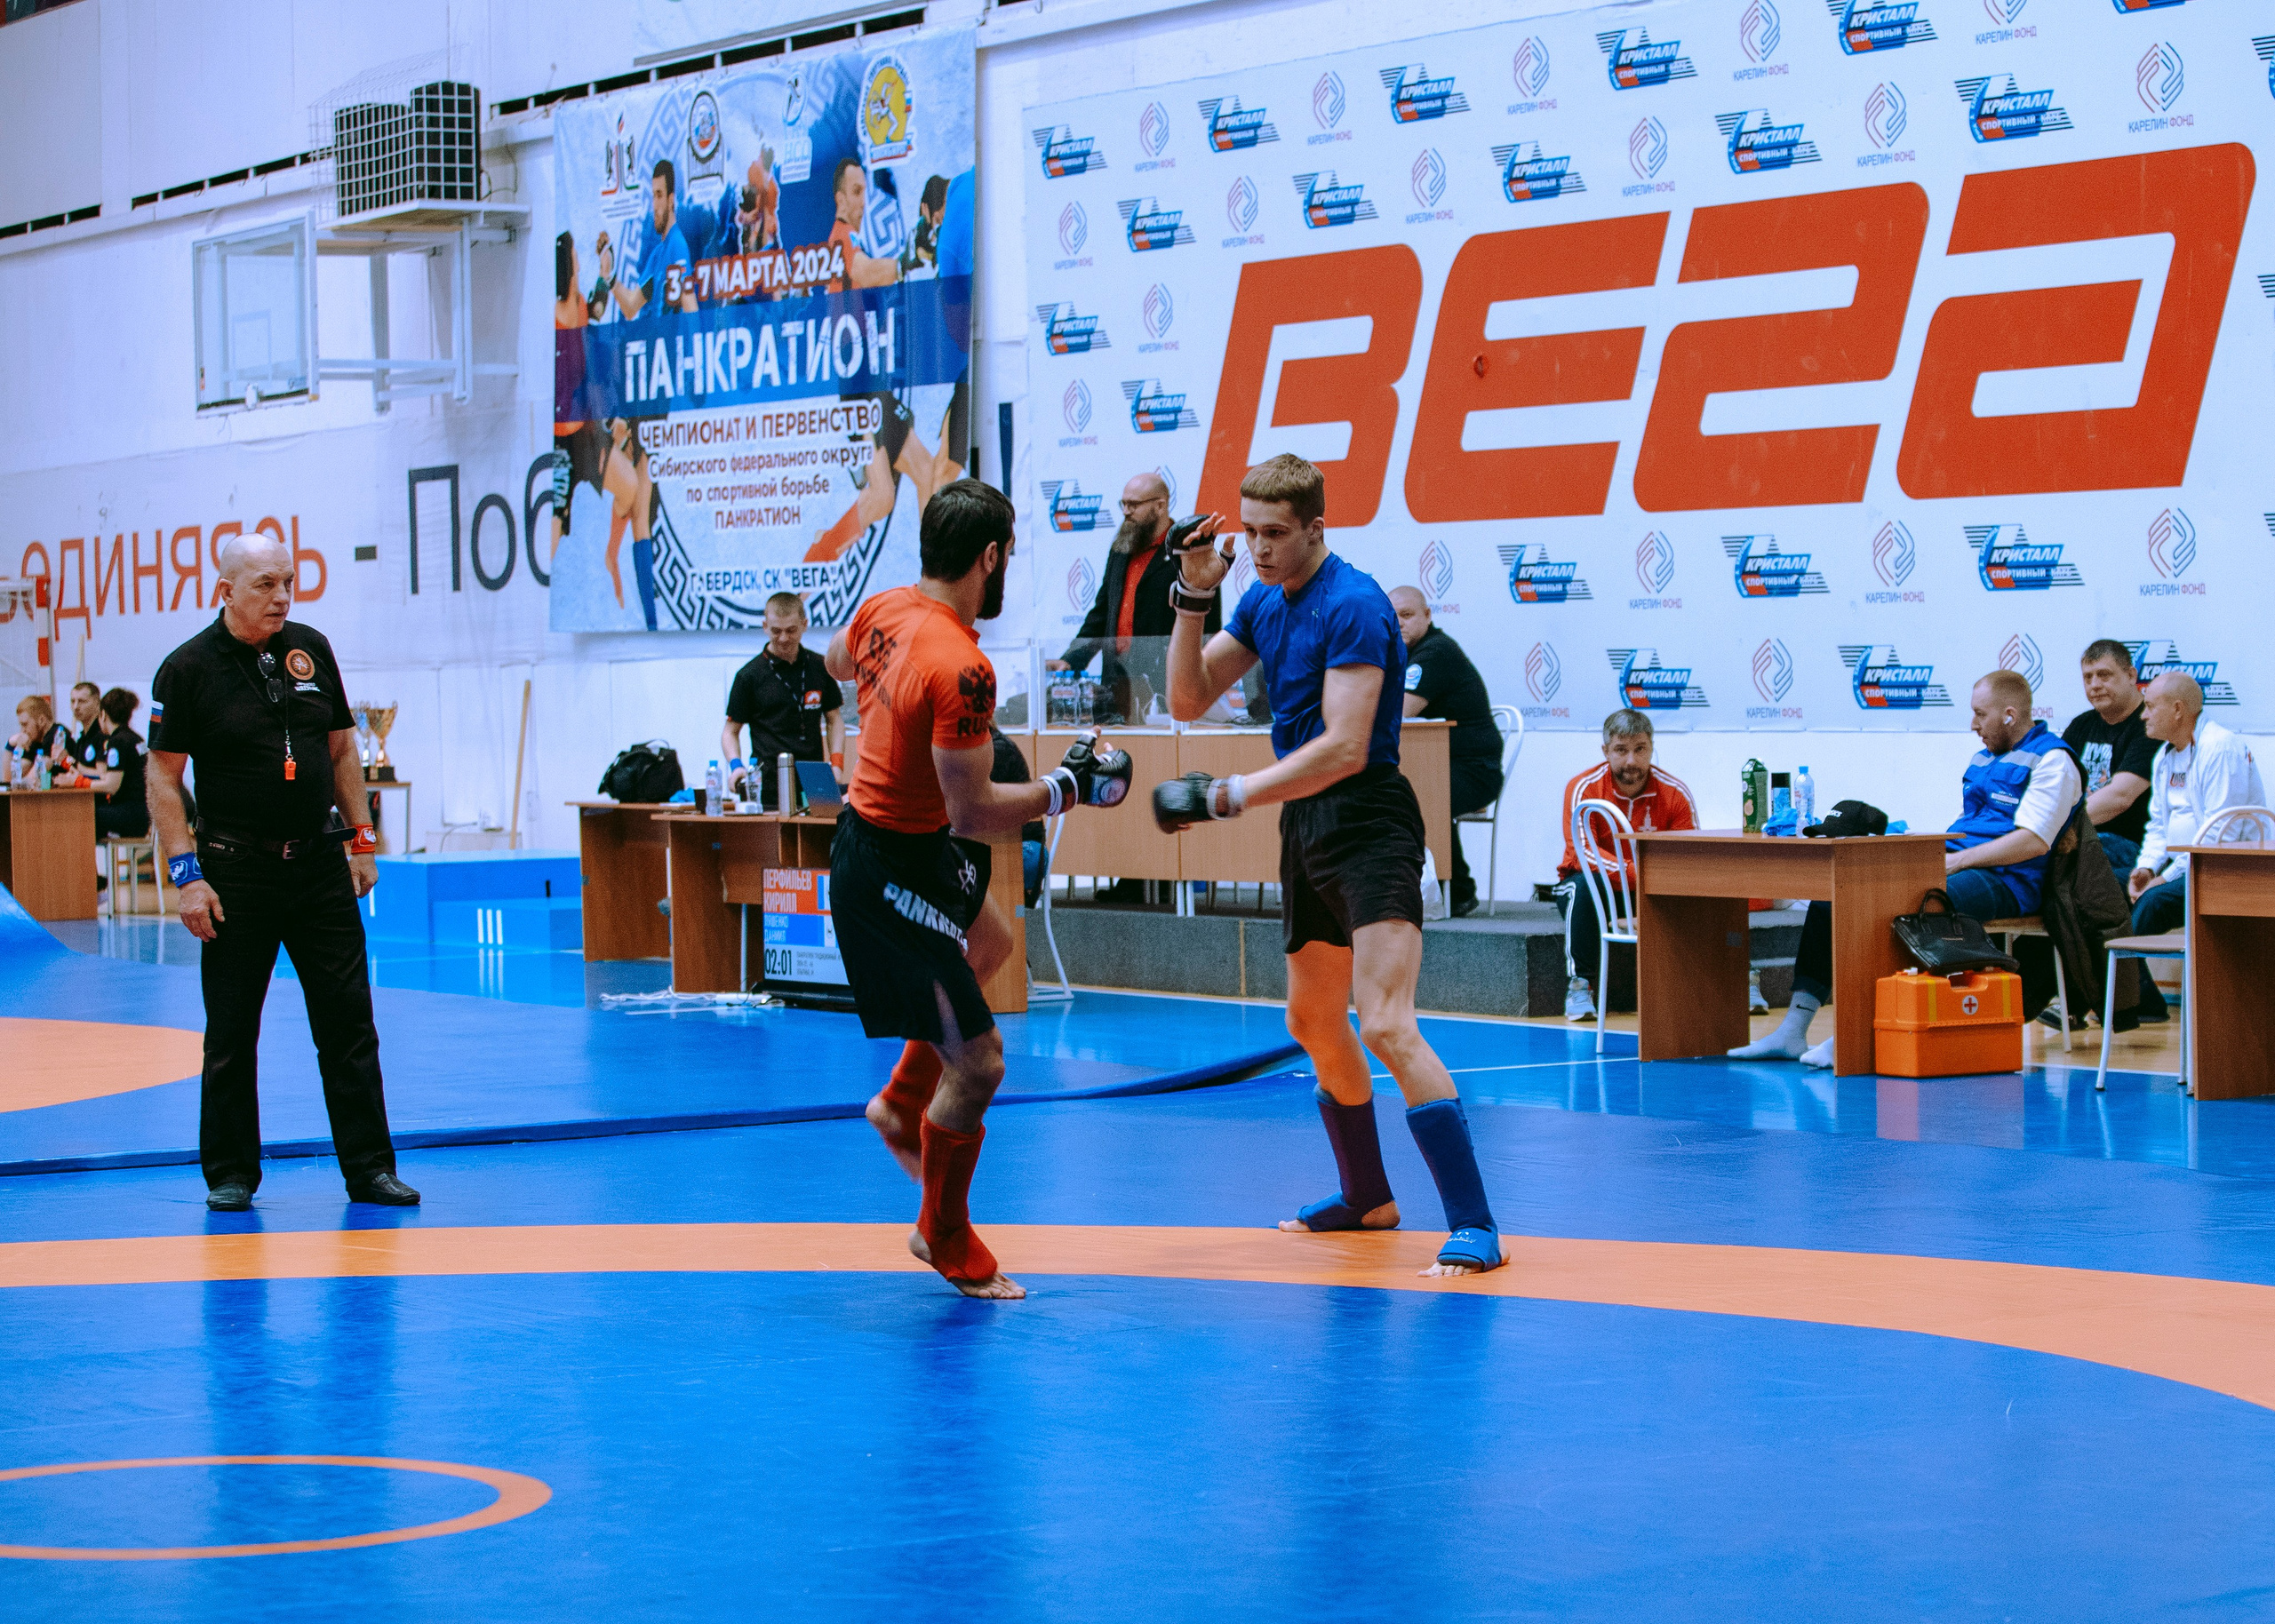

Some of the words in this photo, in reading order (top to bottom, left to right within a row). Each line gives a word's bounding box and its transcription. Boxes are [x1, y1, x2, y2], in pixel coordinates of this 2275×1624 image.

[1850, 5, 1914, 28] КРИСТАЛЛ
[1976, 28, 2013, 44] КАРЕЛИН
[2014, 26, 2037, 39] ФОНД
[1619, 44, 1678, 64] КРИСТАЛЛ
[1733, 68, 1767, 81] КАРЕЛИН
[1768, 64, 1789, 76] ФОНД
[1401, 79, 1453, 100] КРИСТАЛЛ
[1981, 92, 2050, 115] КРИСТАЛЛ
[1982, 115, 2036, 131] СПОРТИВНЫЙ
[2128, 117, 2168, 133] КАРЕЛИН
[2170, 114, 2194, 126] ФОНД
[1739, 127, 1800, 147] КРИСТАЛЛ
[1857, 152, 1892, 167] КАРЕЛИН
[1894, 150, 1915, 162] ФОНД
[1513, 158, 1569, 179] КРИСТАЛЛ
[1623, 186, 1655, 197] КАРЕЛИН
[1656, 181, 1675, 193] ФОНД
[667, 268, 682, 301] 3
[697, 266, 710, 297] 7
[713, 254, 789, 295] МАРТА
[793, 245, 844, 284] 2024
[625, 307, 895, 402] ПАНКРАТИОН
[641, 418, 740, 448] ЧЕМПИОНАТ
[746, 415, 756, 439] И
[762, 404, 881, 438] ПЕРВЕНСТВО
[650, 456, 726, 479] Сибирского
[730, 449, 818, 475] федерального
[822, 444, 873, 466] округа
[687, 487, 702, 504] по
[707, 477, 777, 504] спортивной
[782, 474, 830, 499] борьбе
[715, 505, 801, 529] ПАНКРАТИОН
[1991, 547, 2060, 563] КРИСТАЛЛ
[1520, 564, 1574, 579] КРИСТАЛЛ
[1744, 557, 1808, 572] КРИСТАЛЛ
[1991, 568, 2046, 579] СПОРТИВНЫЙ
[763, 568, 781, 589] СК
[1866, 593, 1902, 604] КАРЕЛИН
[1903, 591, 1925, 603] ФОНД
[2140, 584, 2180, 596] КАРЕЛИН
[2181, 583, 2206, 595] ФОНД
[1630, 599, 1661, 609] КАРЕЛИН
[1662, 598, 1682, 609] ФОНД
[1629, 671, 1688, 684] КРИСТАЛЛ
[1865, 668, 1930, 682] КРИСТАЛЛ
[1865, 689, 1917, 697] СПОРТИВНЫЙ
[1551, 707, 1569, 719] ФОНД
[1747, 707, 1780, 719] КАРЕЛИН
[1782, 707, 1802, 719] ФОНД
[763, 869, 812, 891] ПЕРФИЛЬЕВ
[763, 892, 797, 913] КИРИЛЛ
[764, 948, 792, 975] 02:01
